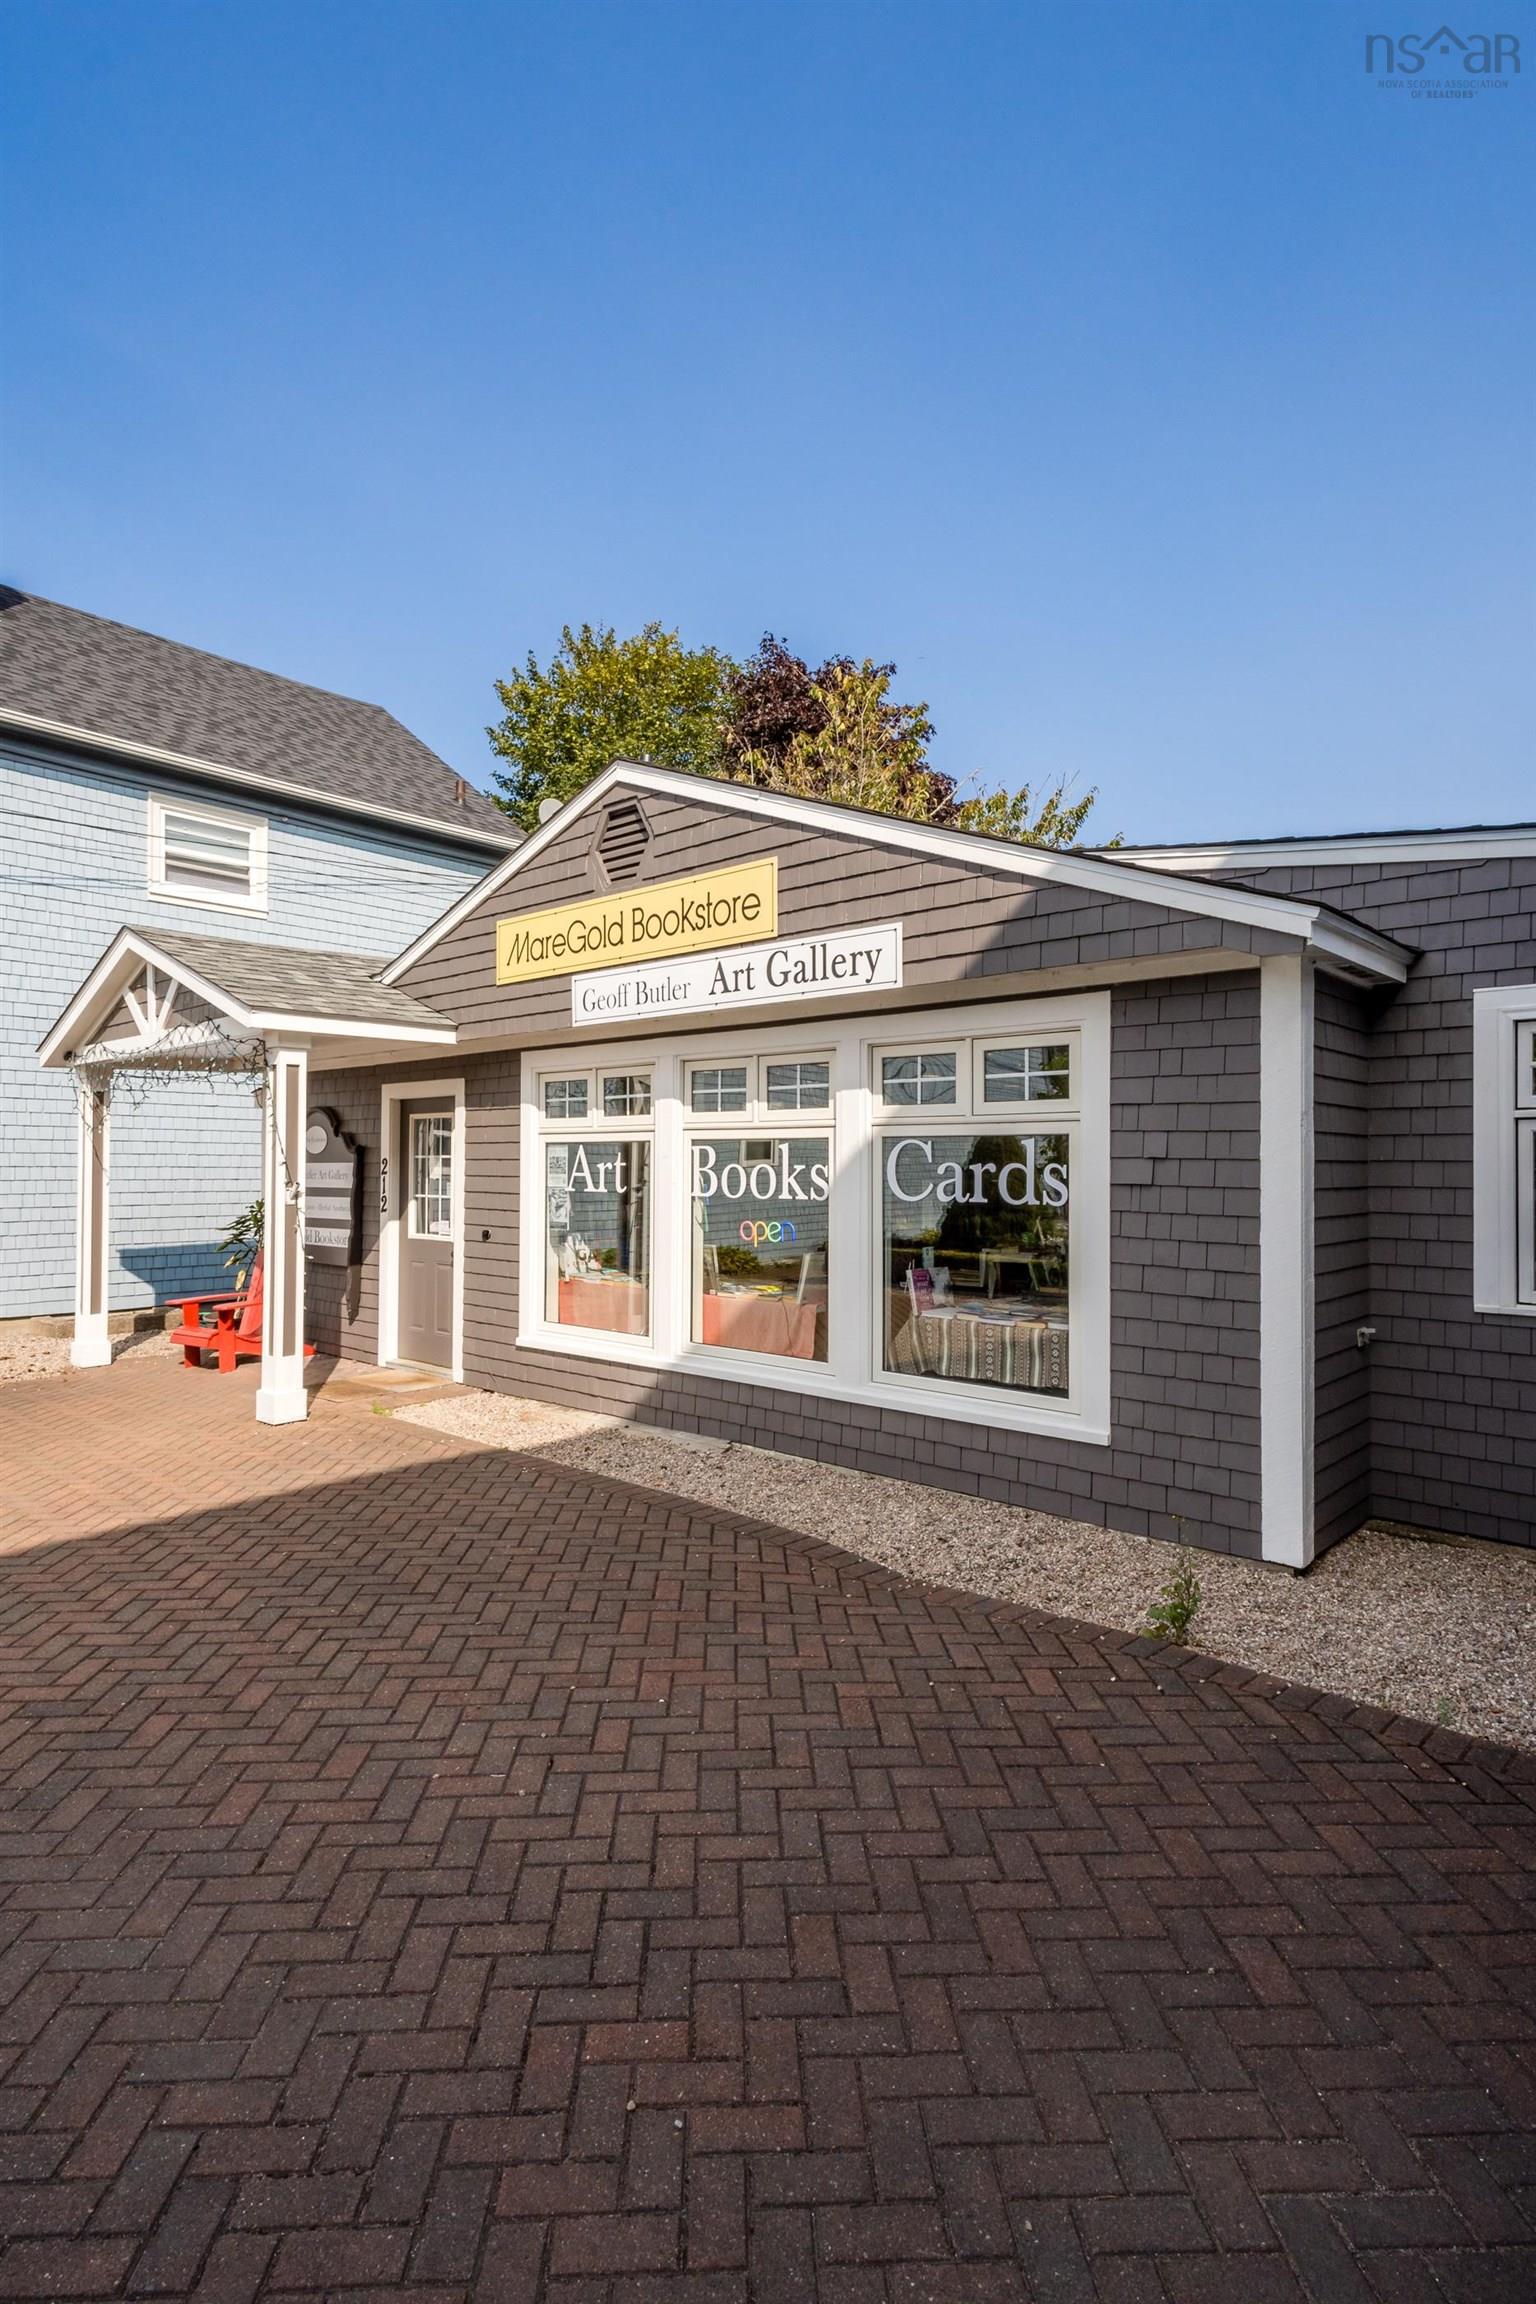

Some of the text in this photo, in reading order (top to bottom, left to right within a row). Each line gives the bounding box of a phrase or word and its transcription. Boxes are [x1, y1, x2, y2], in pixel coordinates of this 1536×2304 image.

[506, 892, 762, 966] MareGold Bookstore
[582, 943, 882, 1013] Geoff Butler Art Gallery
[565, 1144, 627, 1193] Art
[691, 1142, 829, 1201] Books
[886, 1138, 1069, 1207] Cards
[739, 1220, 796, 1248] open
